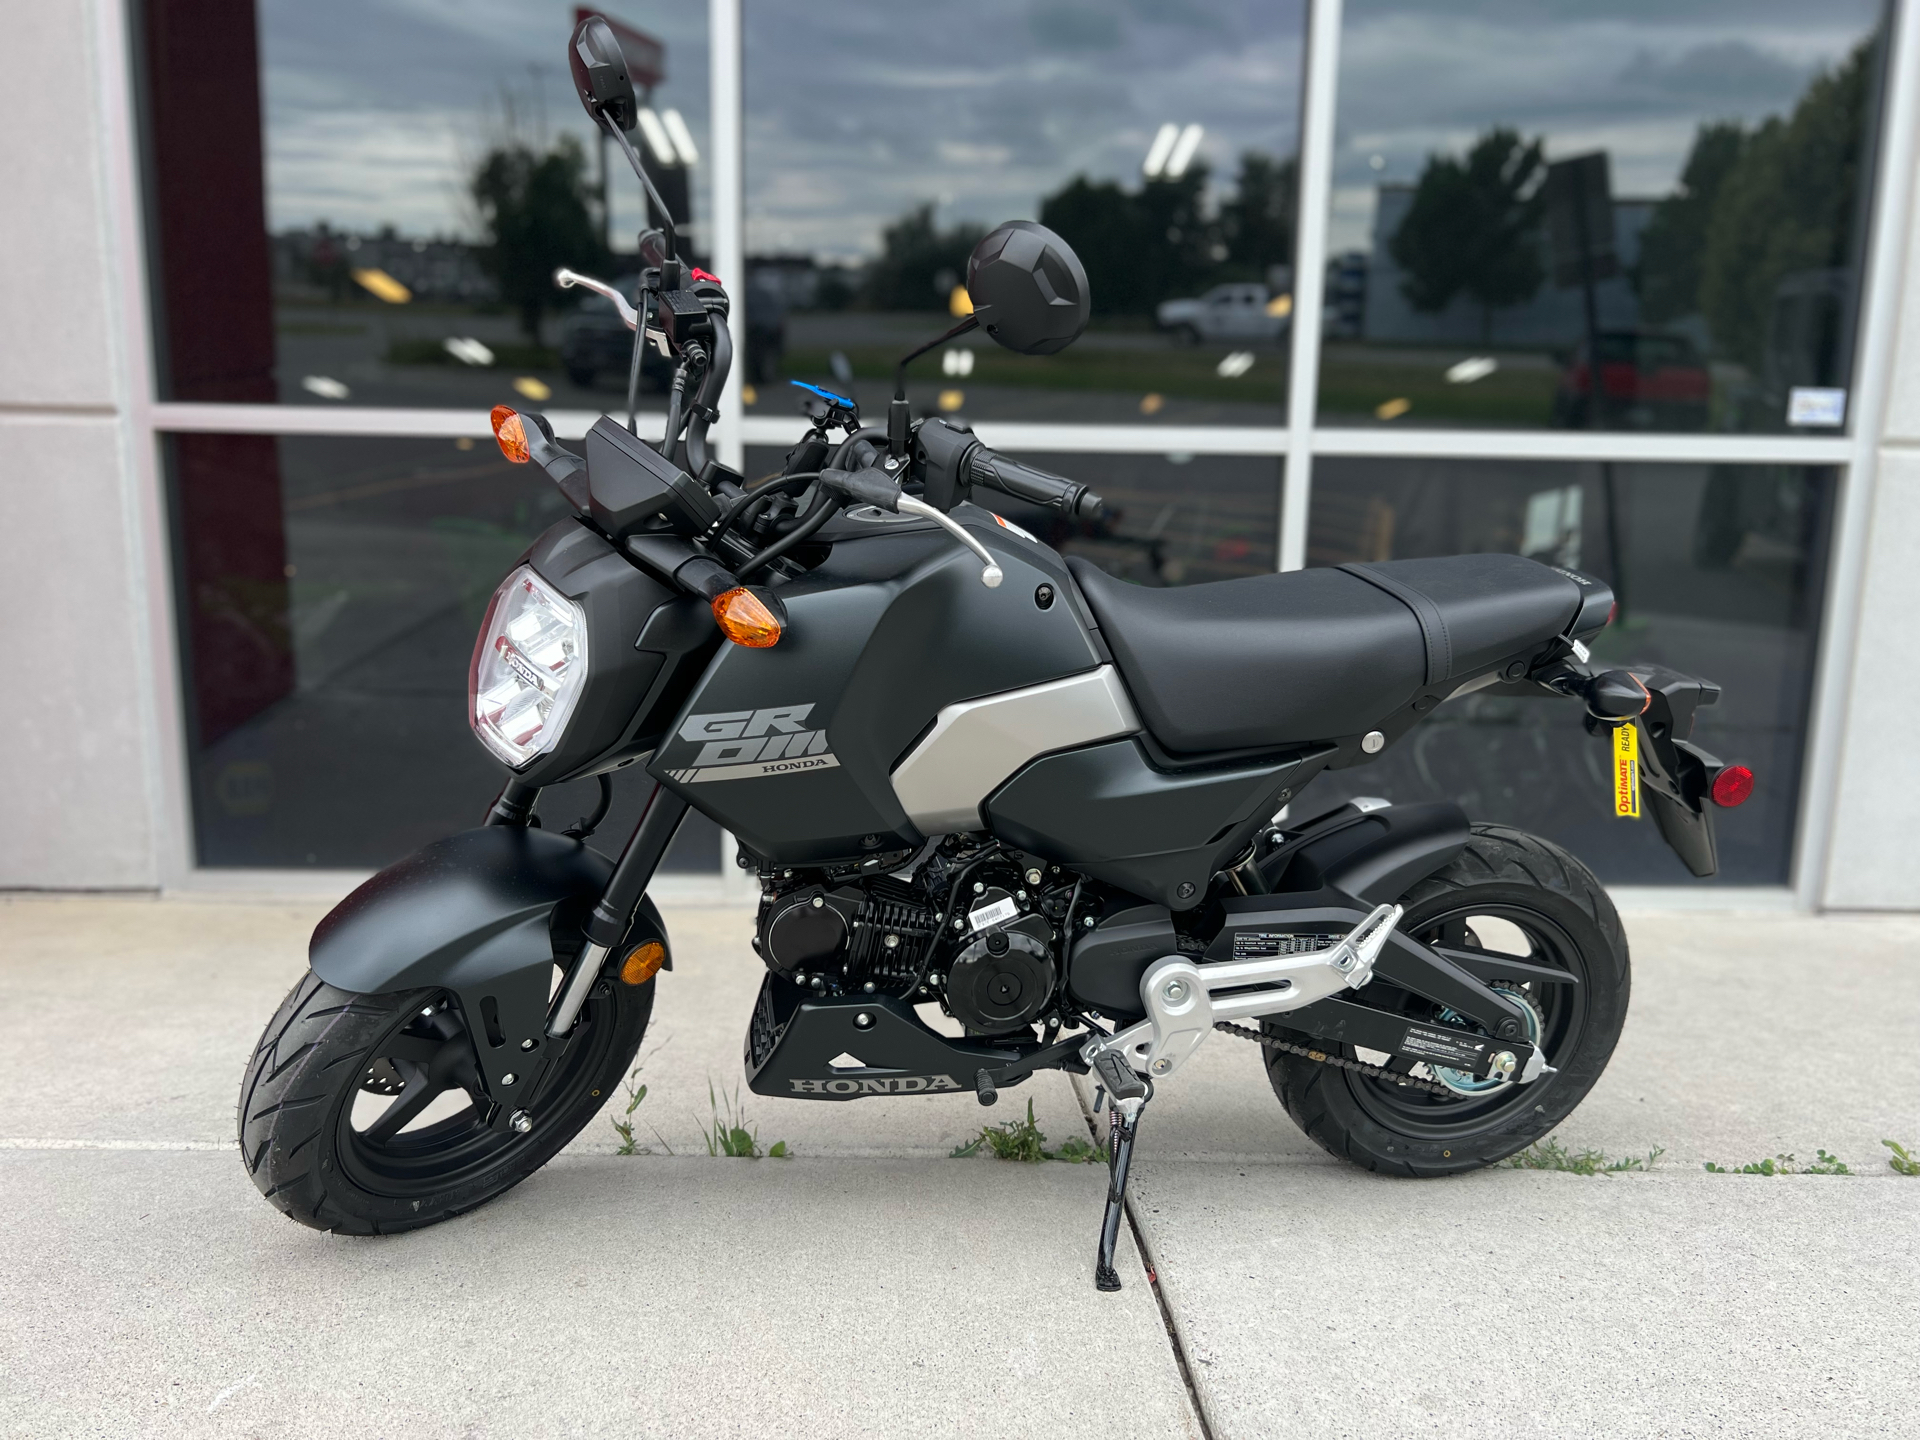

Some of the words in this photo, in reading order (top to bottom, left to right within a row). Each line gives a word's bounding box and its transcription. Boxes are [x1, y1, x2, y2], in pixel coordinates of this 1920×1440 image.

[505, 651, 540, 689] HONDA
[1621, 726, 1630, 752] READY
[762, 758, 829, 773] HONDA
[1618, 759, 1631, 813] OptiMATE
[788, 1074, 962, 1094] HONDA
